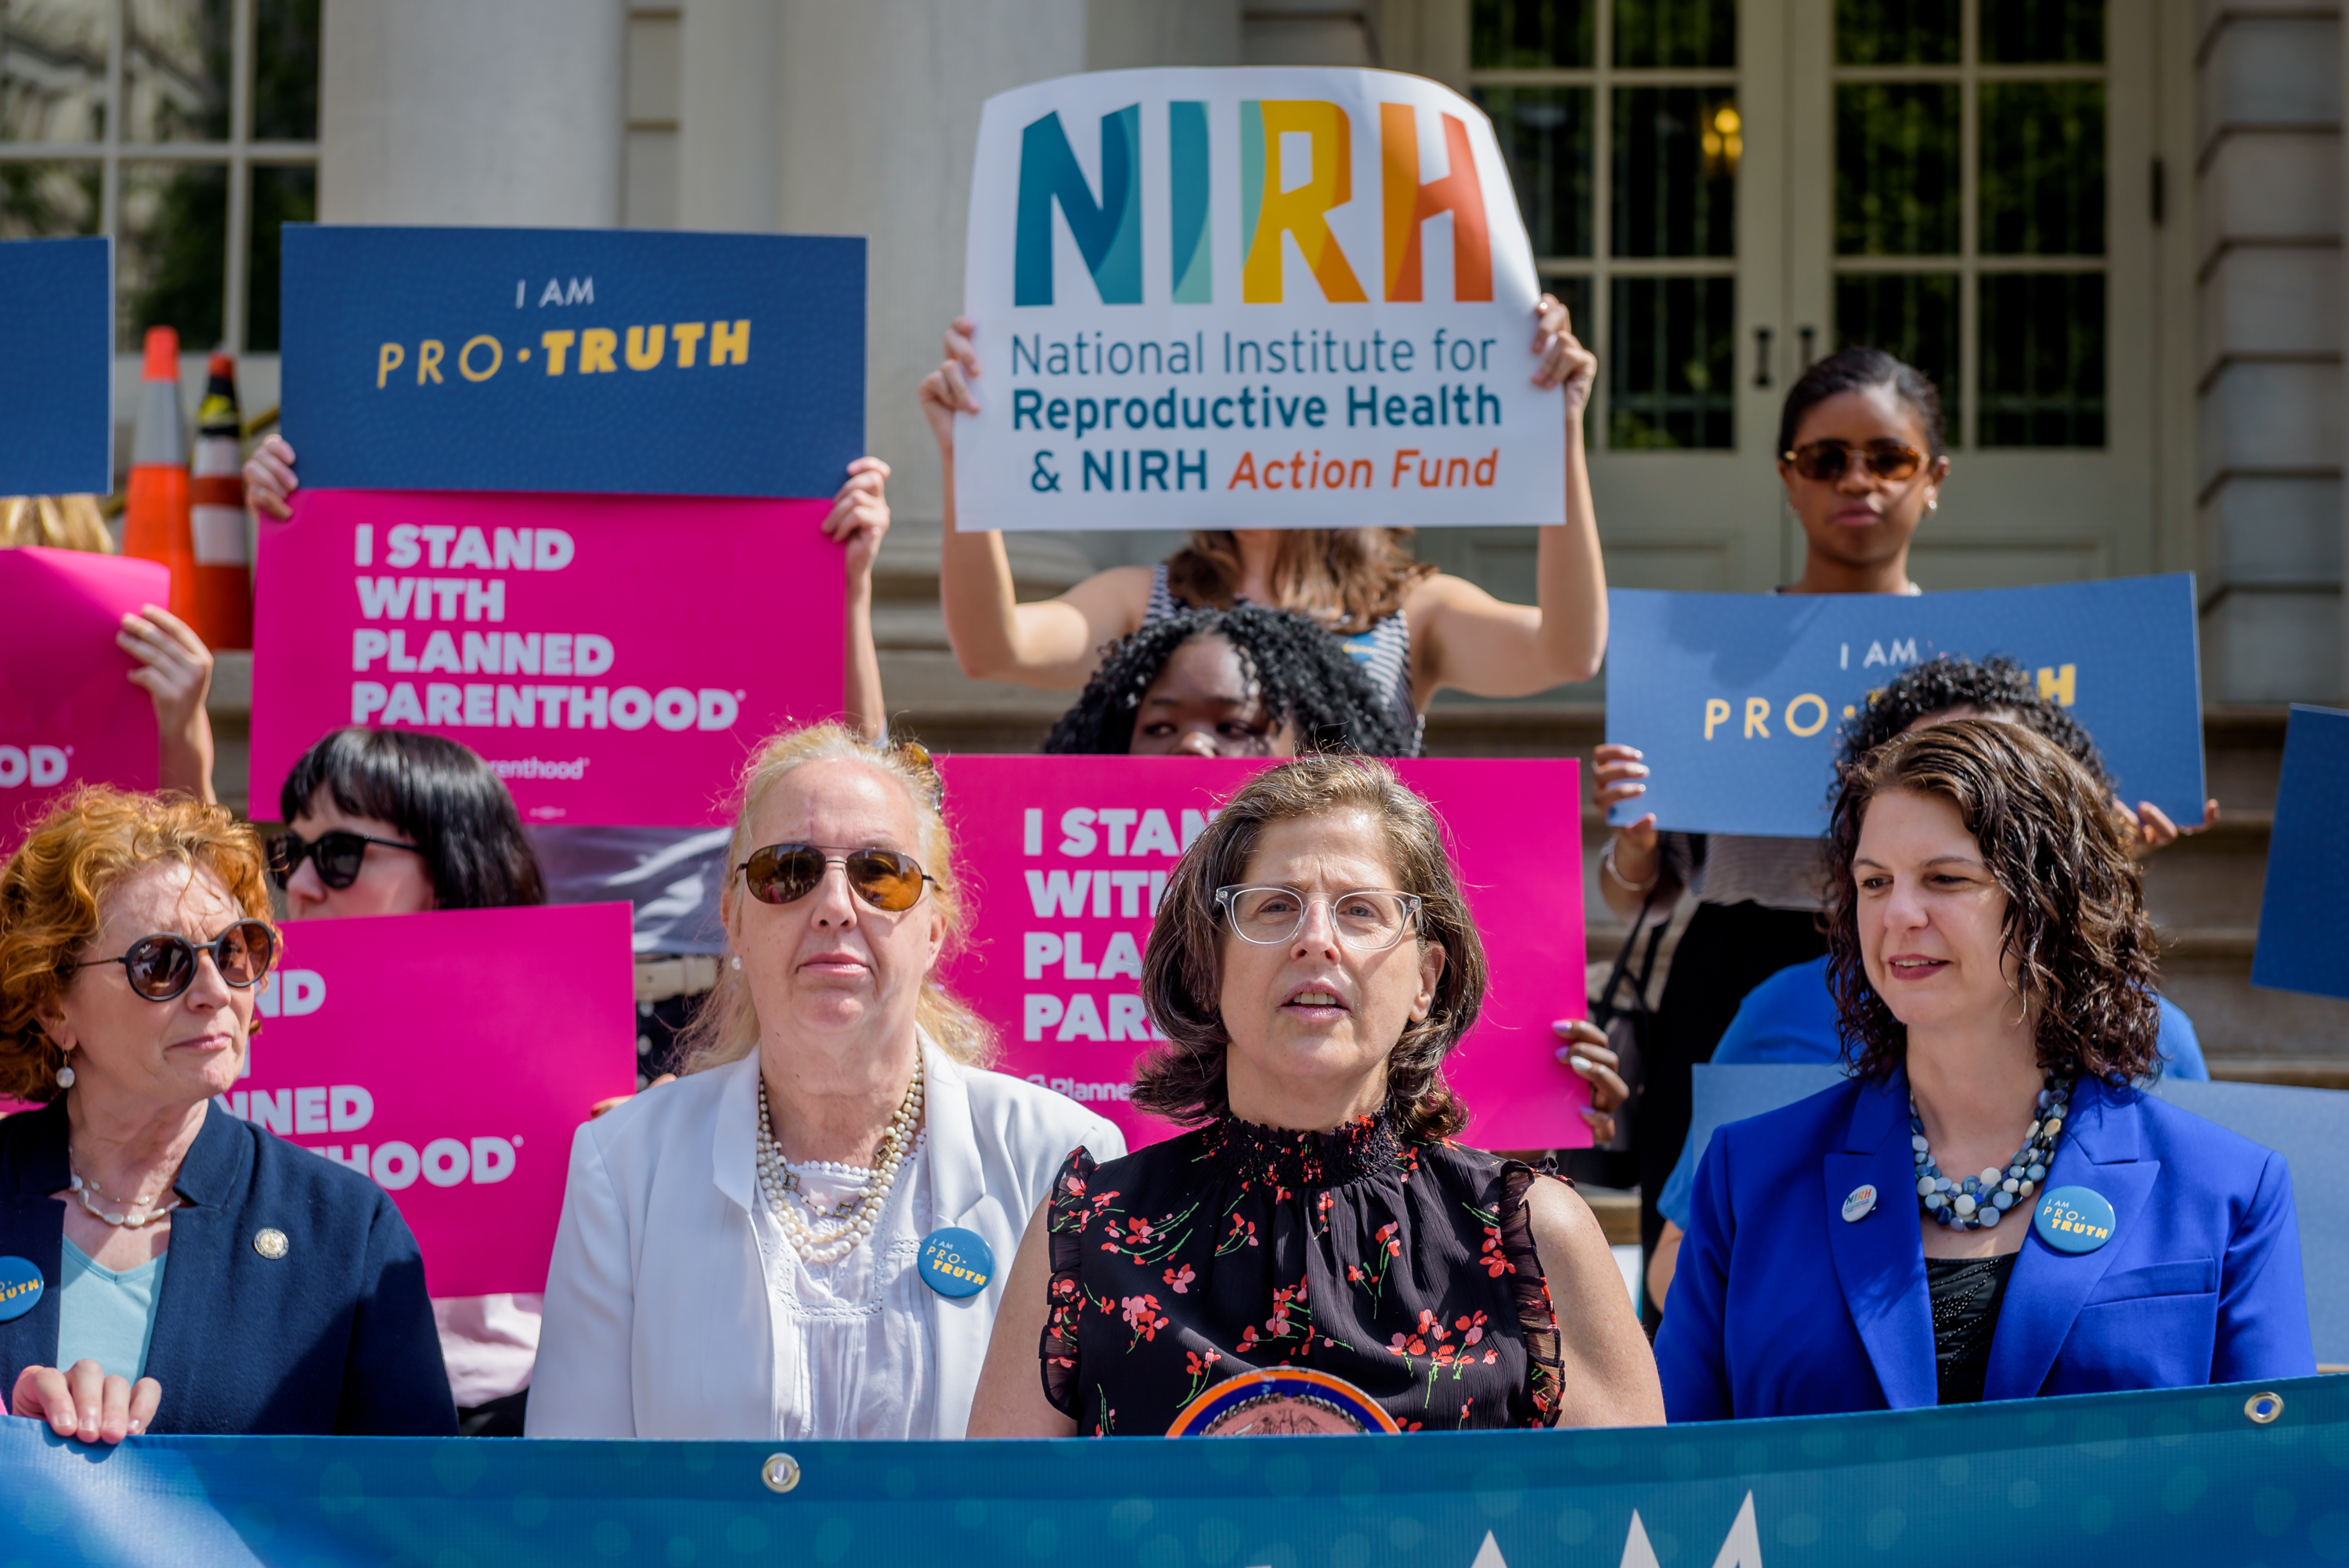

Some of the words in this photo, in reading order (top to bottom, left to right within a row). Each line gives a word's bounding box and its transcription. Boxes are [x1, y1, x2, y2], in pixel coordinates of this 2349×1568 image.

[1015, 99, 1494, 307] NIRH
[515, 279, 526, 309] I
[539, 276, 595, 308] AM
[1012, 330, 1203, 376] National
[1223, 329, 1416, 373] Institute
[1432, 328, 1497, 371] for
[1013, 387, 1328, 439] Reproductive
[1347, 384, 1502, 427] Health
[1030, 449, 1062, 492] &
[1083, 449, 1208, 492] NIRH
[1226, 449, 1374, 491] Action
[1391, 448, 1499, 489] Fund
[355, 523, 374, 567] I
[385, 523, 576, 571] STAND
[355, 575, 506, 622] WITH
[352, 628, 615, 676] PLANNED
[1840, 642, 1849, 670] I
[1863, 636, 1918, 669] AM
[1024, 808, 1043, 856] I
[1058, 807, 1223, 858] STAN
[1024, 870, 1168, 918] WIT
[1050, 1077, 1131, 1102] Planne
[1846, 1188, 1872, 1206] NIRH
[2054, 1200, 2069, 1209] AM
[938, 1241, 954, 1249] AM
[2051, 1218, 2108, 1239] TRUTH
[0, 1279, 38, 1303] RUTH
[933, 1260, 987, 1285] TRUTH
